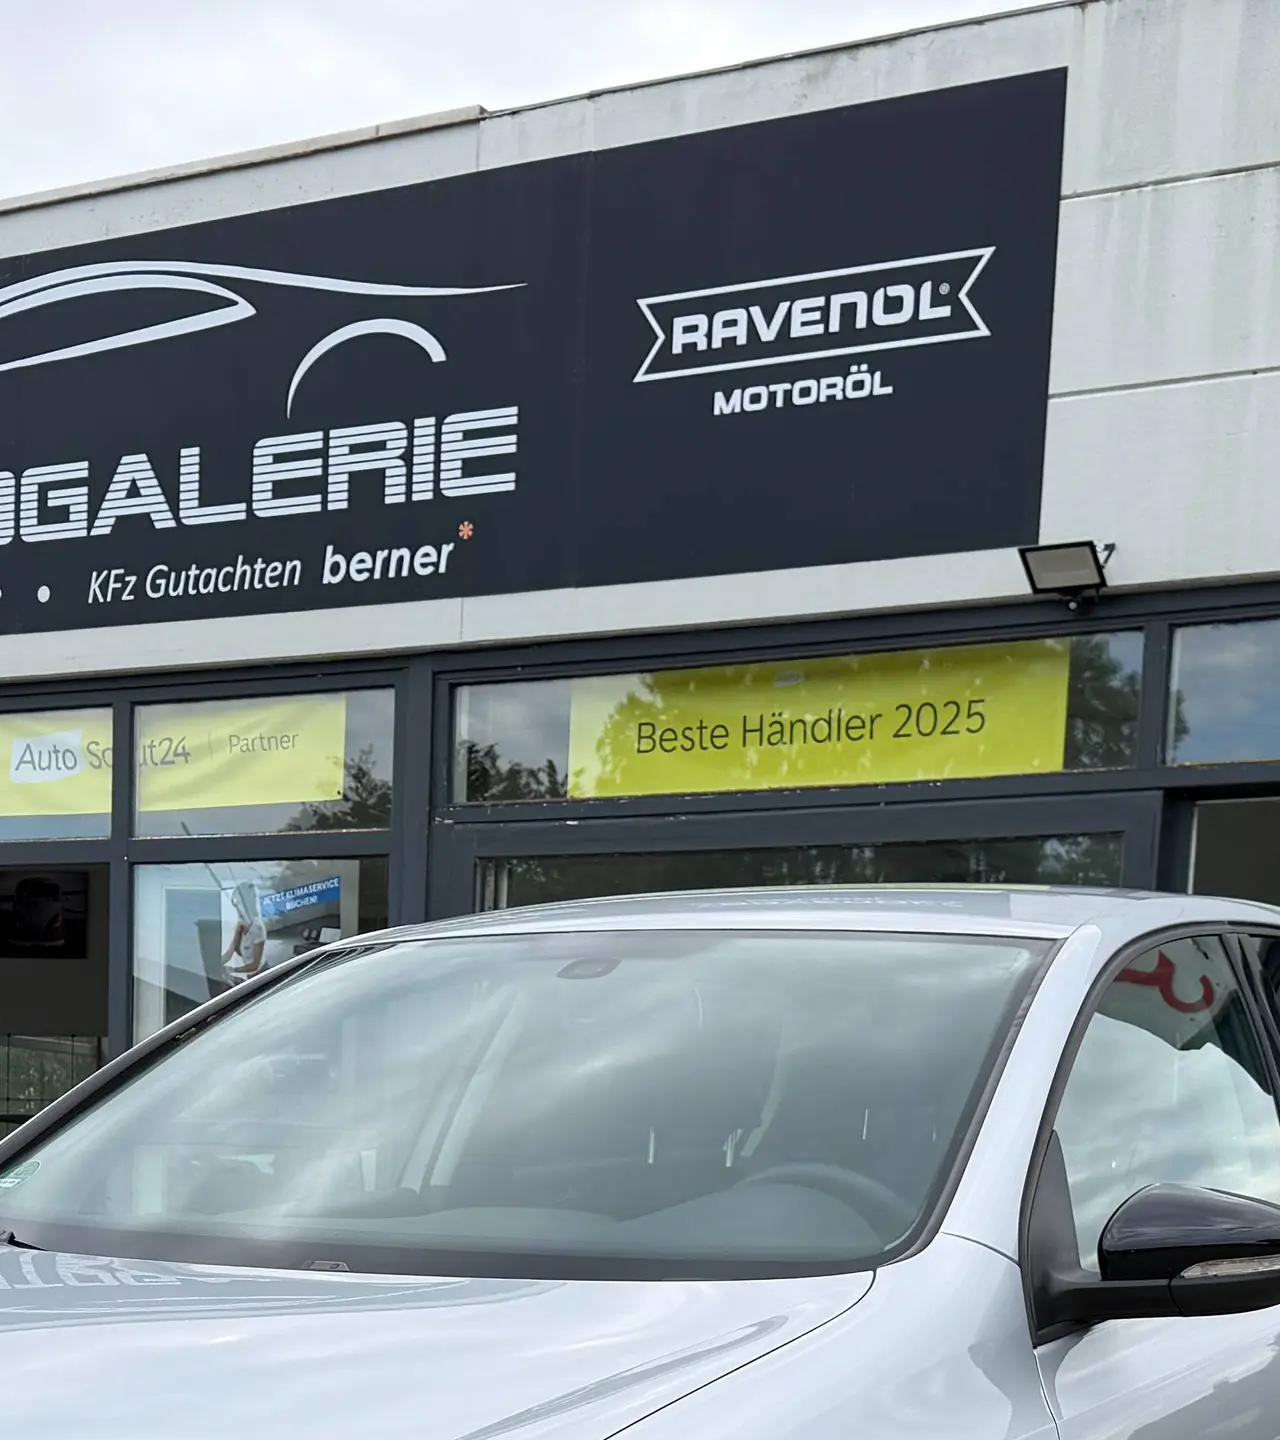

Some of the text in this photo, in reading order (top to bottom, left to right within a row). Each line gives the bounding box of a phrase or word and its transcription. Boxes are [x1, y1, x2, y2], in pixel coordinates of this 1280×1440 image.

[672, 281, 951, 354] RAVENOL
[714, 364, 893, 415] MOTORÖL
[87, 554, 302, 604] KFz Gutachten
[322, 542, 455, 585] berner
[636, 698, 985, 754] Beste Händler 2025
[14, 732, 299, 771] Auto Scut24 Partner
